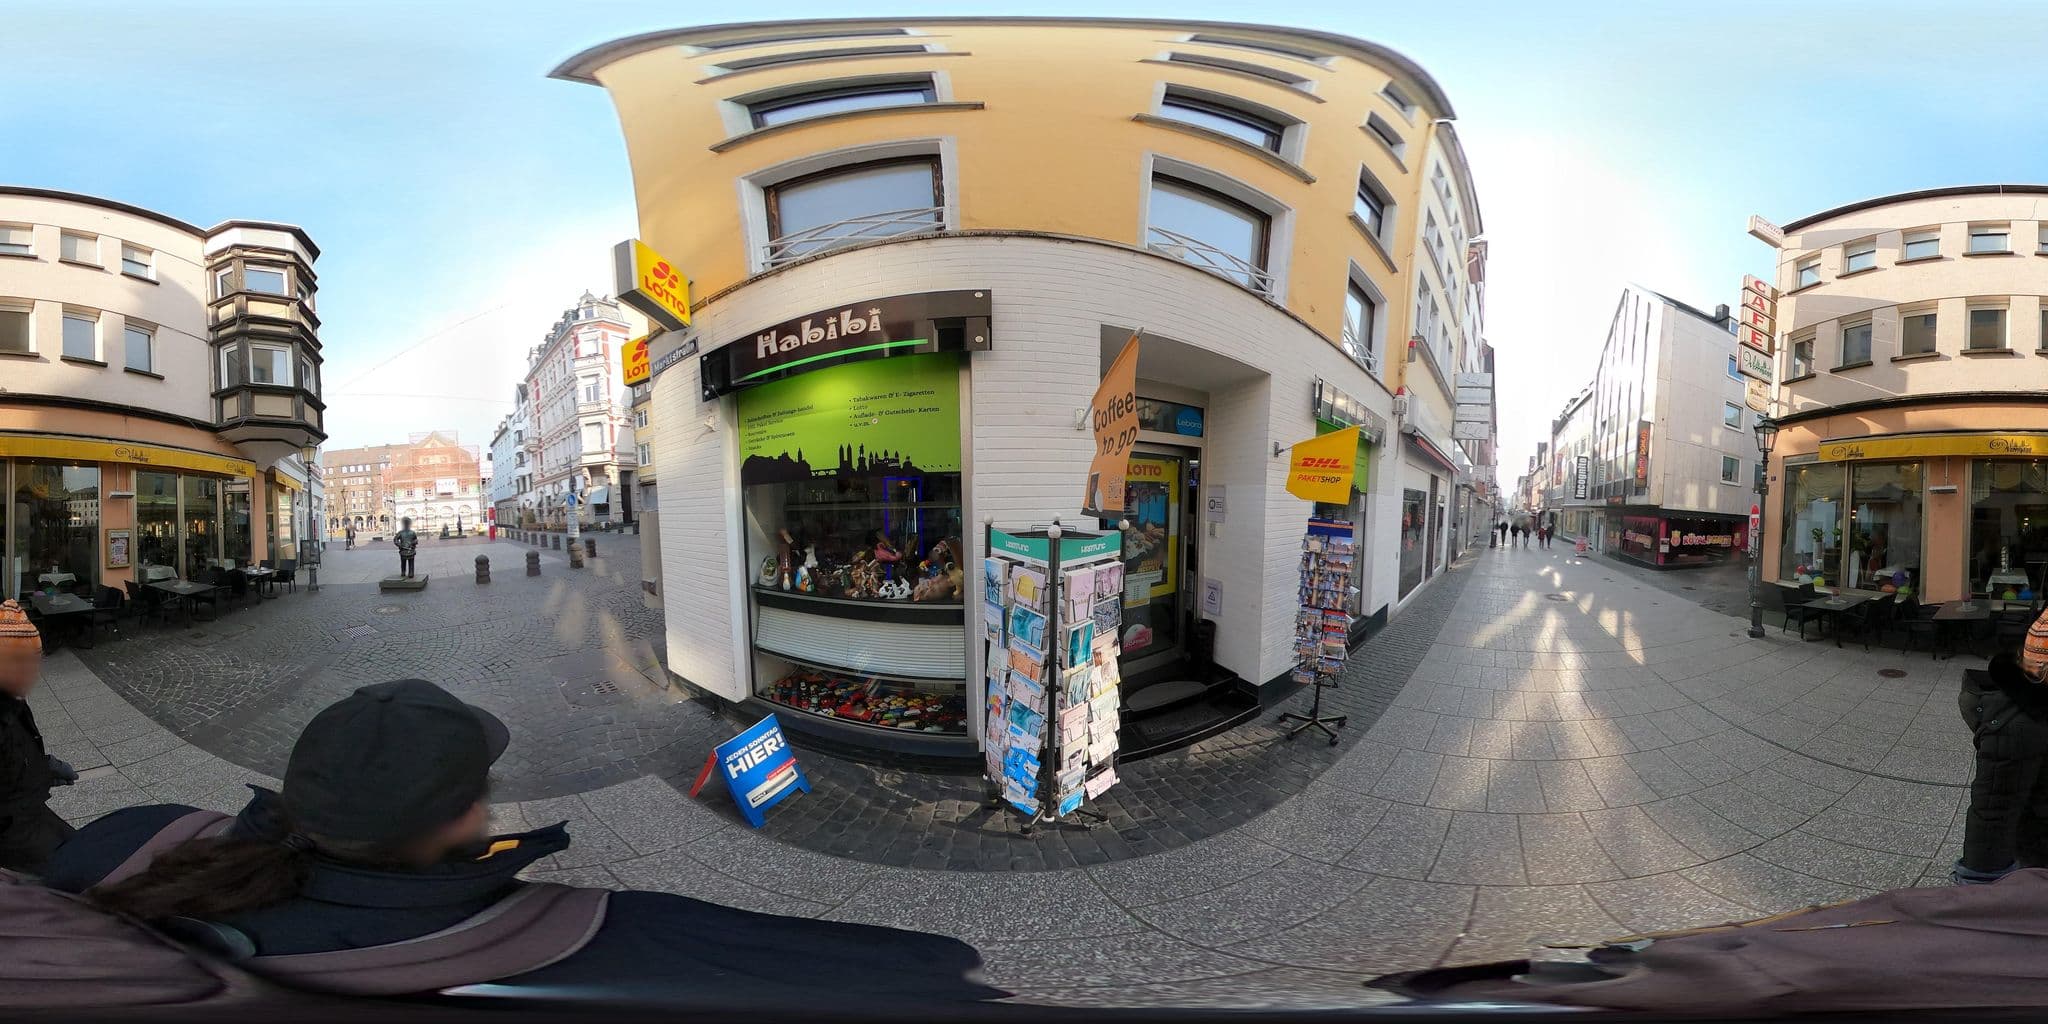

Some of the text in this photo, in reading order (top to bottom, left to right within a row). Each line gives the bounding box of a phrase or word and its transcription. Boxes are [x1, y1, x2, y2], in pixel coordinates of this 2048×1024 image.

[643, 274, 687, 315] LOTTO
[1750, 279, 1767, 348] CAFE
[756, 307, 882, 360] Habibi
[626, 361, 650, 380] LOTT
[1094, 391, 1134, 433] Coffee
[1102, 426, 1137, 457] to go
[1127, 463, 1162, 477] LOTTO
[1297, 474, 1342, 484] PAKETSHOP
[1301, 457, 1341, 469] DHL
[1575, 457, 1588, 498] Incognito
[725, 726, 778, 764] JEDEN SONNTAG
[727, 732, 785, 780] HIER!
